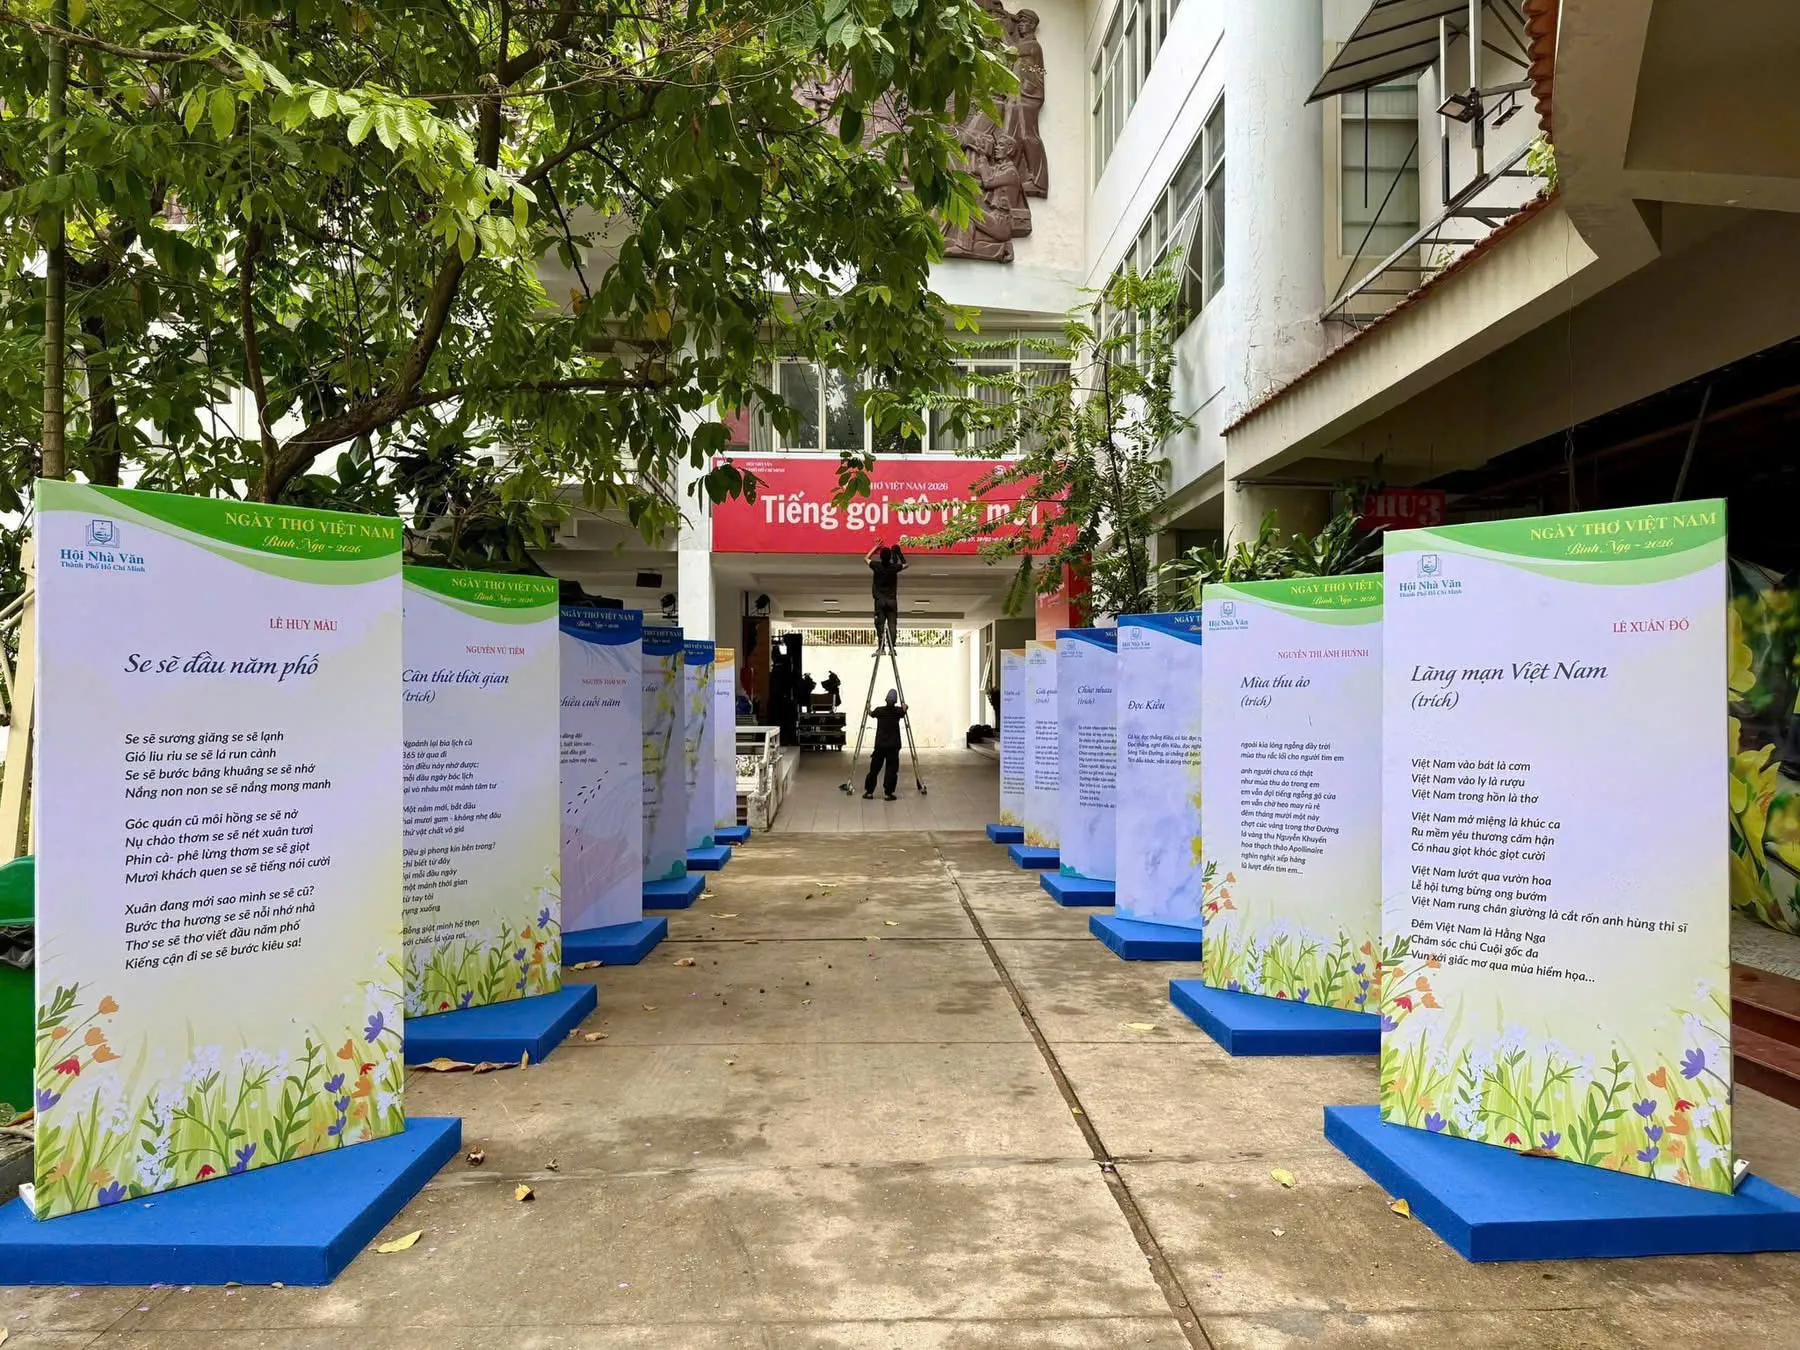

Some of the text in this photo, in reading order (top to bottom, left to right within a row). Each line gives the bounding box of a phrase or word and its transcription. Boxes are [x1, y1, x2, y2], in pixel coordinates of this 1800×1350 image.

[870, 481, 883, 490] HƠ
[884, 480, 904, 491] VIỆT
[928, 482, 948, 490] 2026
[761, 490, 839, 530] Tiếng
[847, 496, 888, 532] gọi
[225, 512, 394, 538] NGÀY THƠ VIỆT NAM
[1531, 512, 1715, 539] NGÀY THƠ VIỆT NAM
[262, 535, 295, 548] Bính
[296, 538, 325, 552] Ngọ
[1565, 543, 1602, 554] Bính
[1606, 539, 1630, 553] Ngọ
[1643, 537, 1673, 548] 2026
[61, 549, 143, 564] Hội Nhà Văn
[1400, 582, 1415, 592] Hội
[1419, 581, 1438, 589] Nhà
[270, 618, 336, 630] LÊ HUY MẬU
[1613, 620, 1626, 632] LÊ
[1630, 619, 1664, 632] XUÂN
[124, 651, 319, 682] Se sẽ đầu năm phố
[402, 668, 508, 688] Cân thử thời gian
[1411, 660, 1607, 688] Lãng mạn Việt Nam
[1240, 675, 1310, 688] Mùa thu ảo
[402, 690, 435, 703] (trích)
[1240, 695, 1271, 708] (trích)
[1411, 691, 1458, 710] (trích)
[1128, 700, 1164, 711] Đọc Kiều
[125, 734, 139, 744] Se
[142, 734, 155, 743] sẽ
[158, 734, 195, 744] sương
[197, 732, 229, 744] giăng
[246, 732, 257, 741] sẽ
[260, 731, 283, 743] lạnh
[125, 751, 145, 762] Gió
[149, 751, 163, 761] liu
[167, 750, 182, 760] riu
[201, 750, 212, 759] sẽ
[216, 749, 225, 759] lá
[250, 748, 275, 758] cành
[1411, 758, 1430, 769] Việt
[1432, 759, 1455, 768] Nam
[1458, 760, 1475, 769] vào
[1477, 760, 1493, 769] bát
[1497, 761, 1506, 770] là
[125, 770, 139, 780] Se
[142, 769, 155, 779] sẽ
[158, 768, 188, 778] bước
[192, 767, 220, 778] bâng
[223, 766, 263, 776] khuâng
[281, 764, 291, 774] sẽ
[294, 763, 315, 773] nhớ
[1411, 773, 1524, 788] Việt Nam vào ly là rượu
[1412, 789, 1538, 803] Việt Nam trong hồn là thơ
